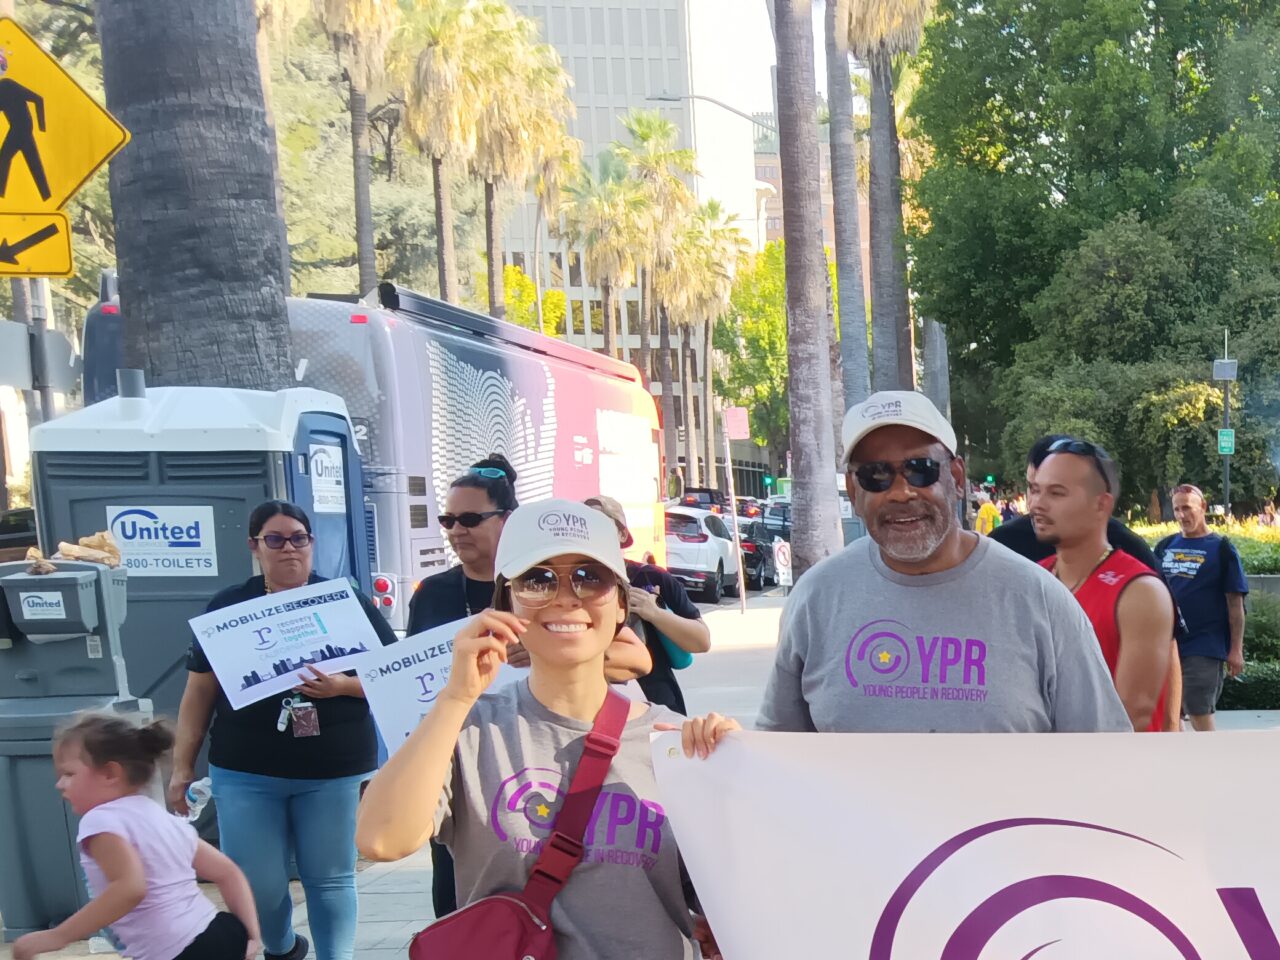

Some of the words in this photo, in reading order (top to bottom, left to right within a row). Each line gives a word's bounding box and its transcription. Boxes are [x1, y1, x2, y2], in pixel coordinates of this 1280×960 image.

[120, 521, 200, 540] United
[563, 513, 588, 530] YPR
[121, 558, 213, 569] -800-TOILETS
[27, 599, 62, 609] United
[277, 615, 312, 628] recovery
[279, 622, 316, 636] happens
[915, 635, 987, 686] YPR
[862, 684, 893, 699] YOUNG
[894, 686, 929, 700] PEOPLE
[930, 687, 939, 700] IN
[940, 687, 989, 703] RECOVERY
[585, 791, 667, 855] YPR
[513, 836, 543, 856] YOUN
